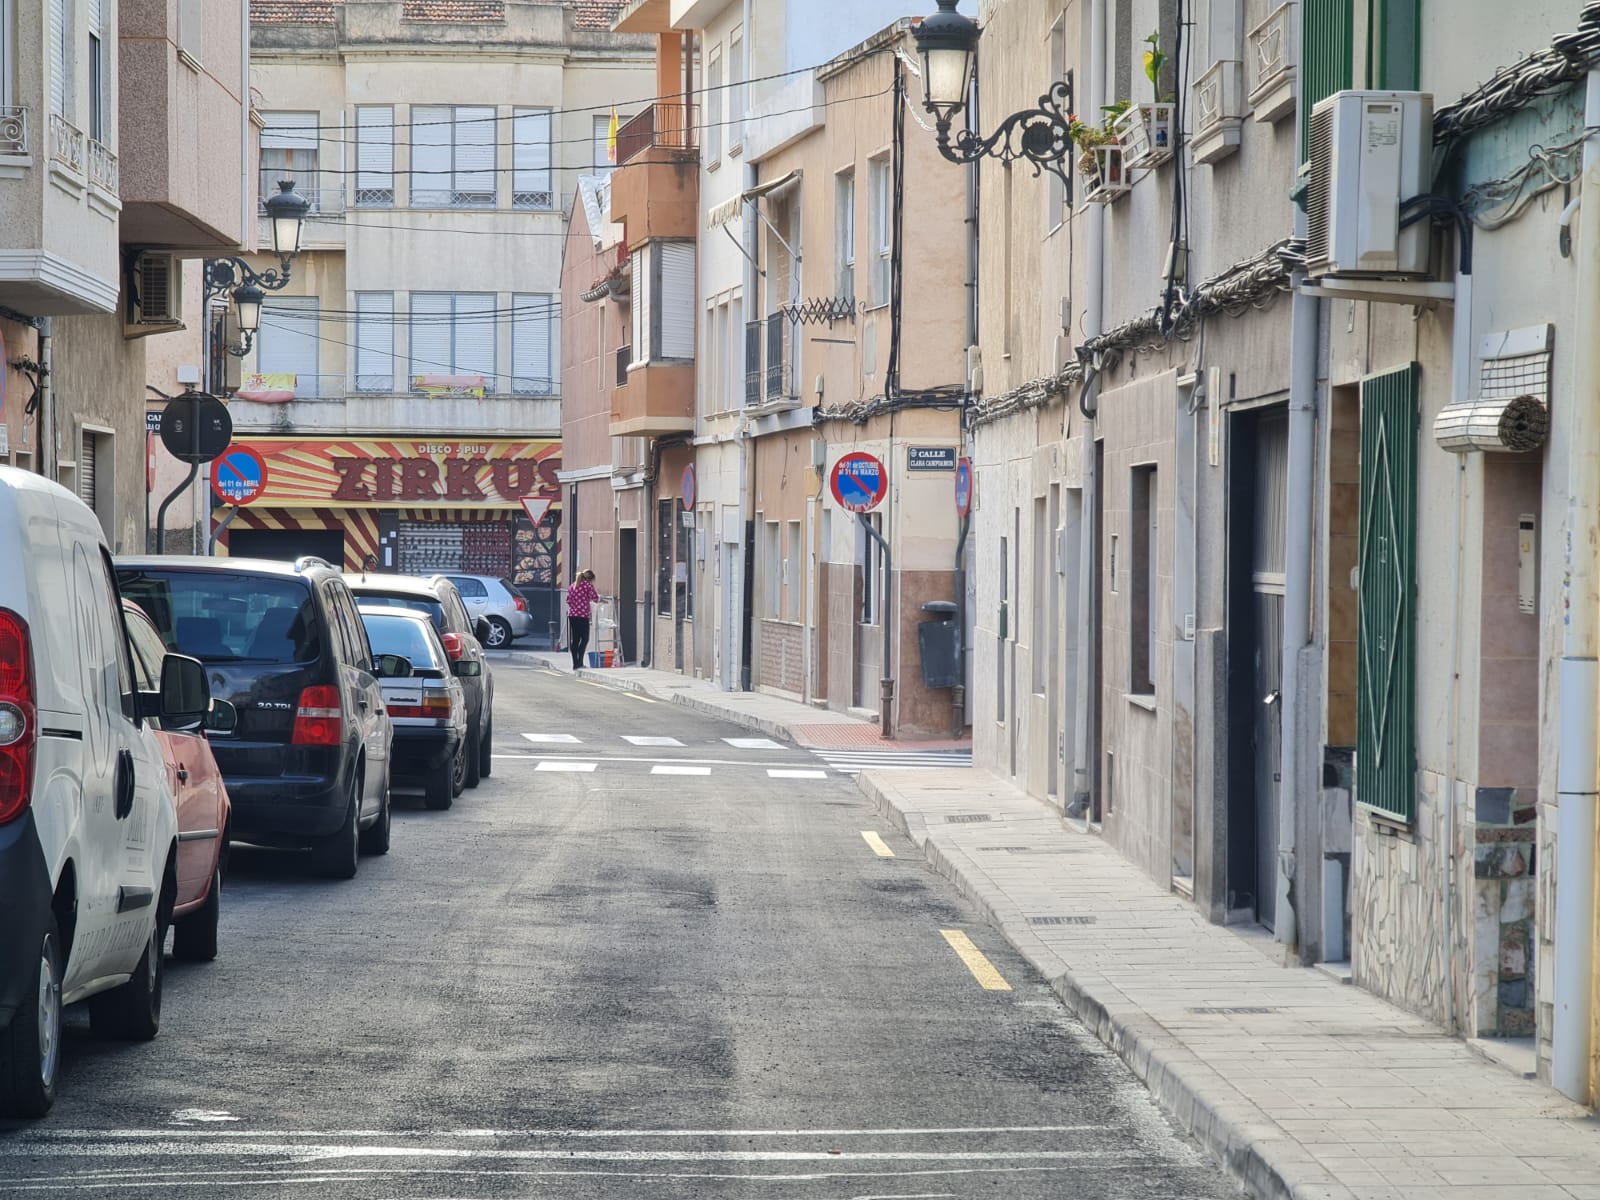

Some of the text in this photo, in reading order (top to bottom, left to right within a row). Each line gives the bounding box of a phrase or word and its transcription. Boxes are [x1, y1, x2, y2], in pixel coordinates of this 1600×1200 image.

[418, 445, 452, 454] DISCO
[464, 445, 486, 454] PUB
[918, 450, 946, 458] CALLE
[332, 457, 562, 501] ZIRKUS
